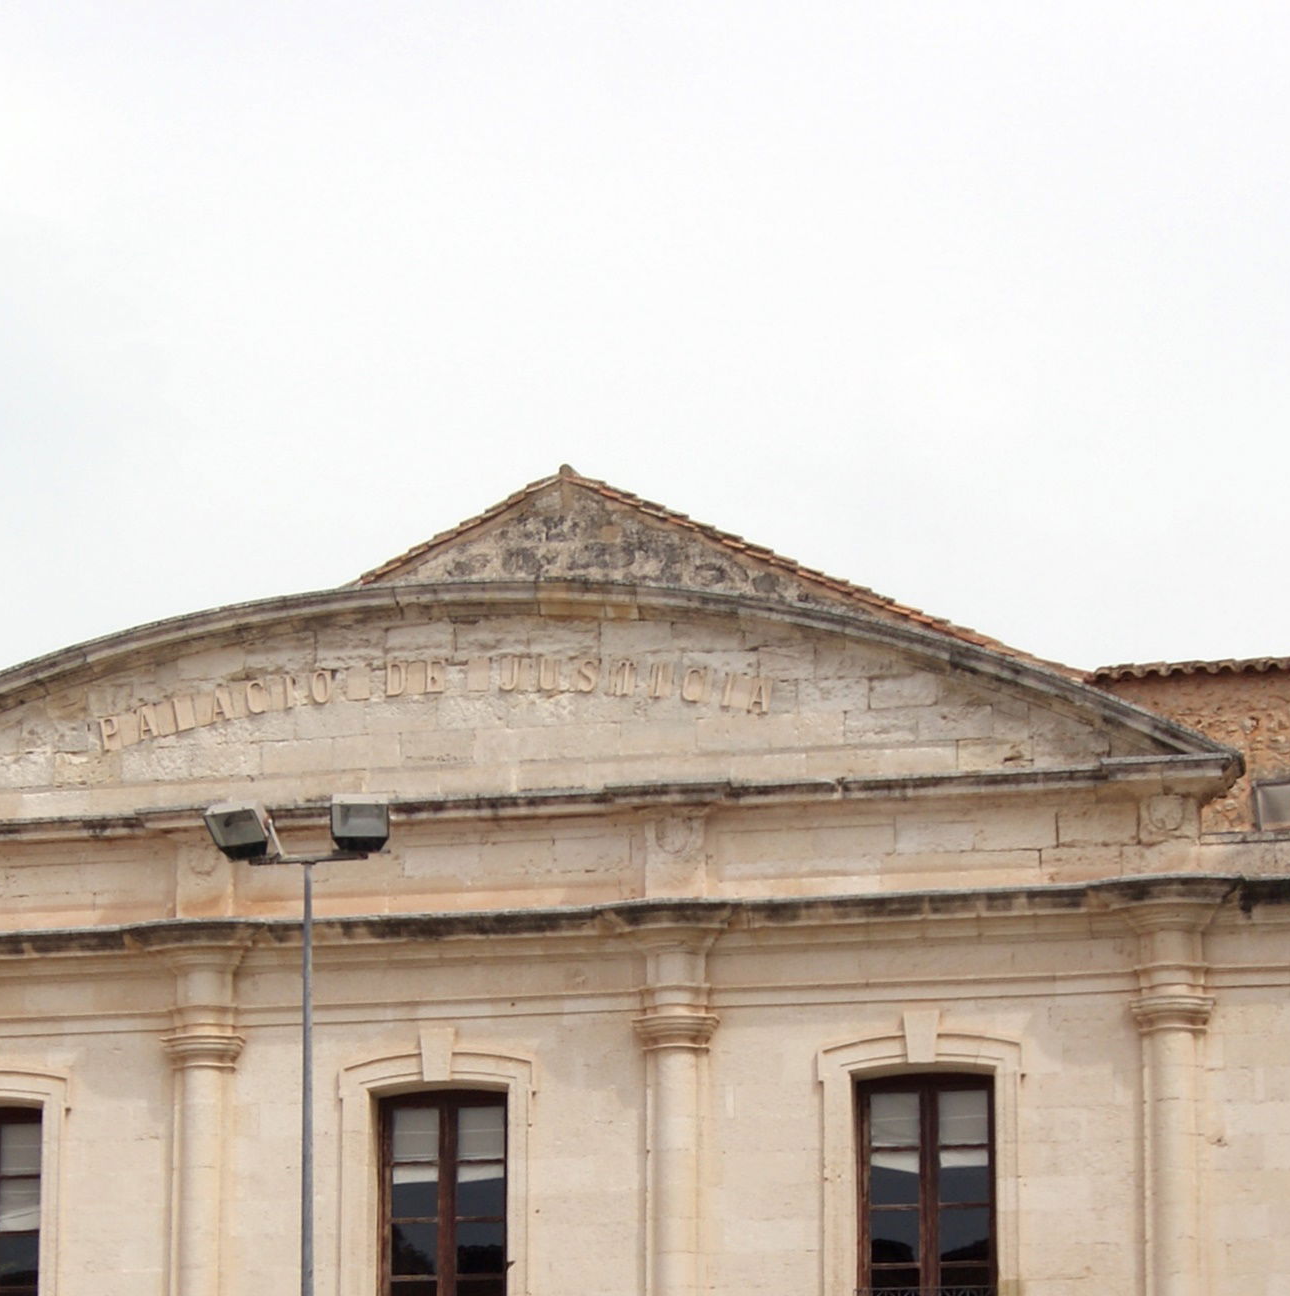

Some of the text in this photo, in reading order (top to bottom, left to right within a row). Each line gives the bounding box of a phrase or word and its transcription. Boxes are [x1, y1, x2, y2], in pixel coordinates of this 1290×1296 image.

[99, 656, 775, 750] PALACIO DE JUSTICIA
